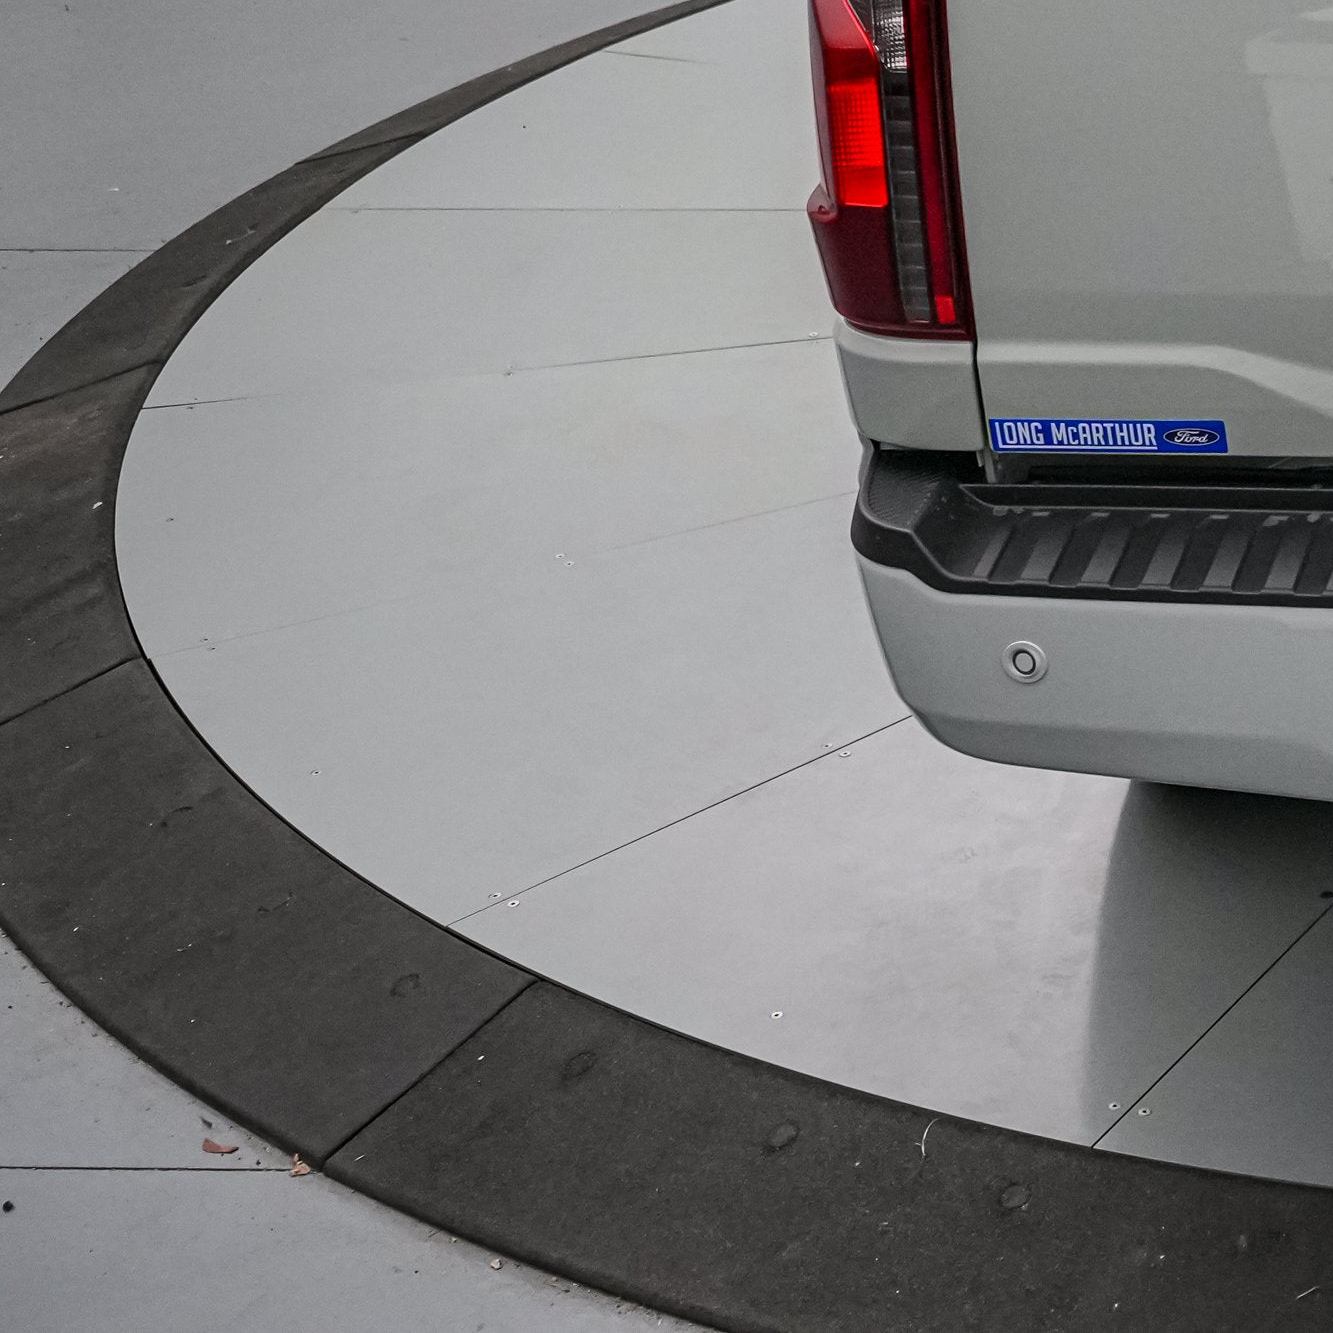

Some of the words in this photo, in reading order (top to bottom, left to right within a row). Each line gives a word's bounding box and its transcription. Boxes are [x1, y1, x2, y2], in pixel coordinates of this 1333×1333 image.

[994, 421, 1045, 446] LONG
[1050, 422, 1157, 446] McARTHUR
[1174, 428, 1208, 443] Ford
